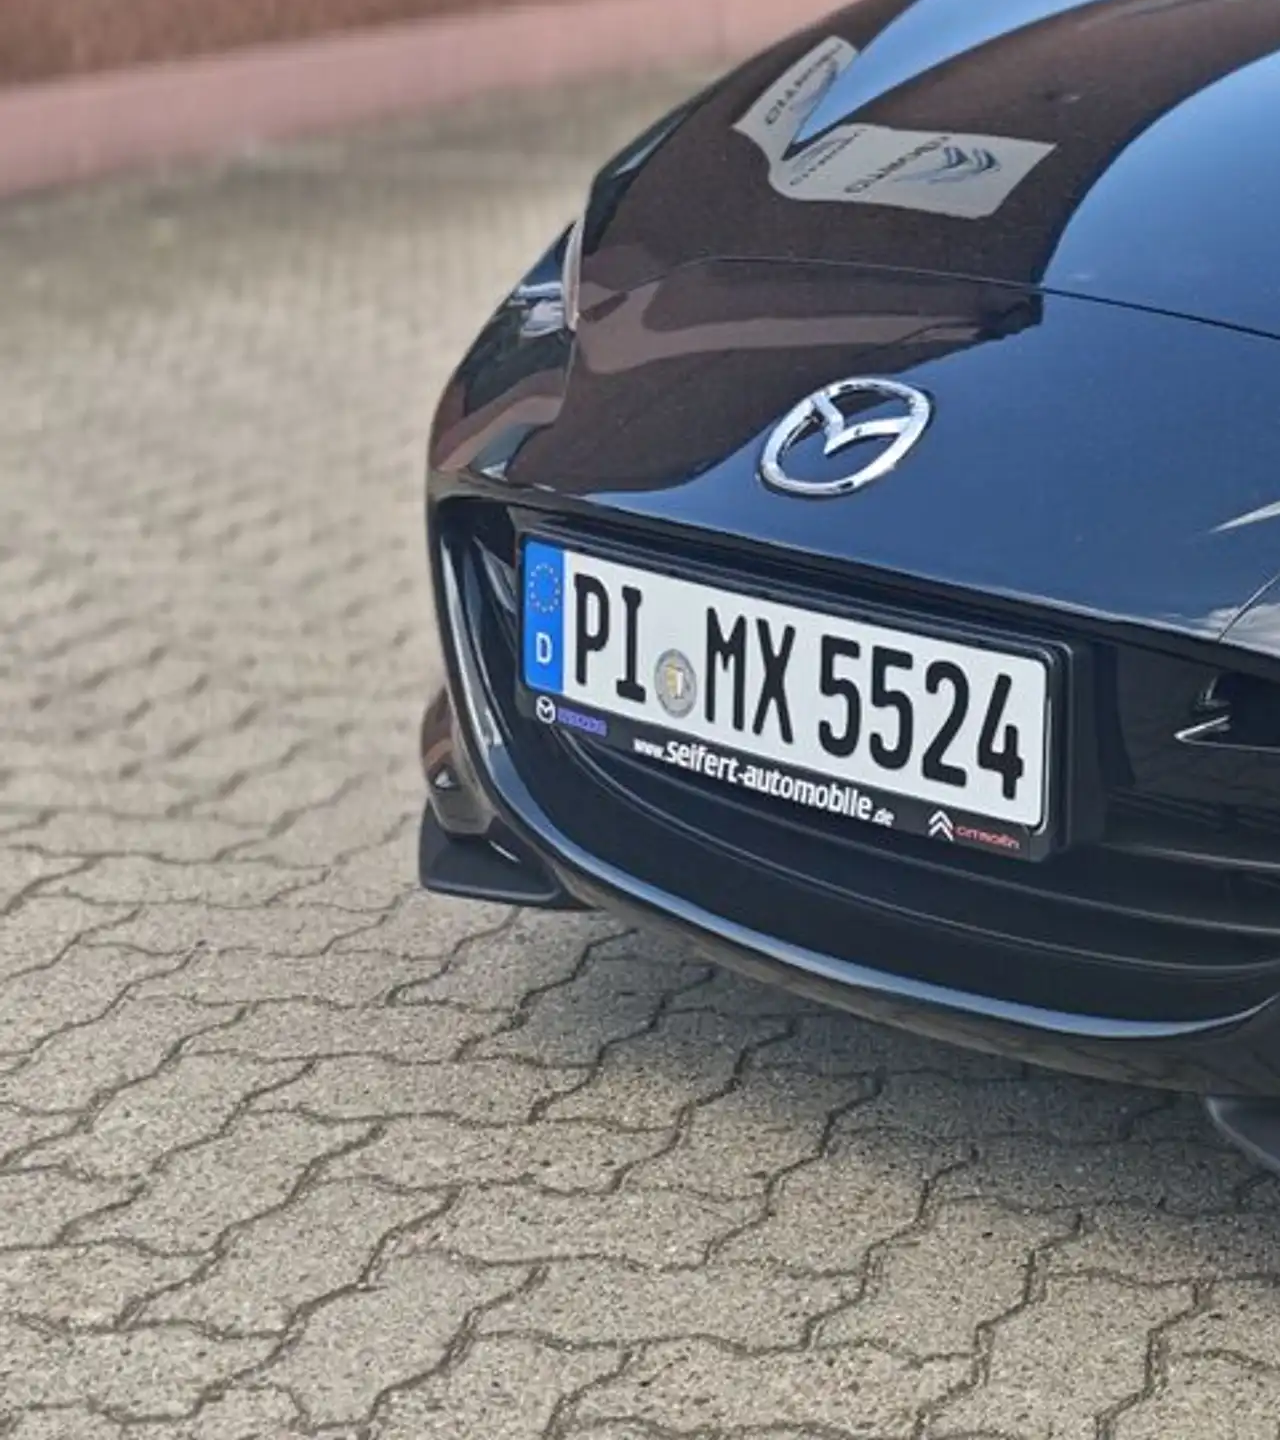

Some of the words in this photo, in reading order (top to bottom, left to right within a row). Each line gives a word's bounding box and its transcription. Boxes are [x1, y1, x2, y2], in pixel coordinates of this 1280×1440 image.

[536, 631, 553, 664] D
[573, 573, 646, 703] PI
[705, 606, 795, 744] MX
[818, 634, 1024, 801] 5524
